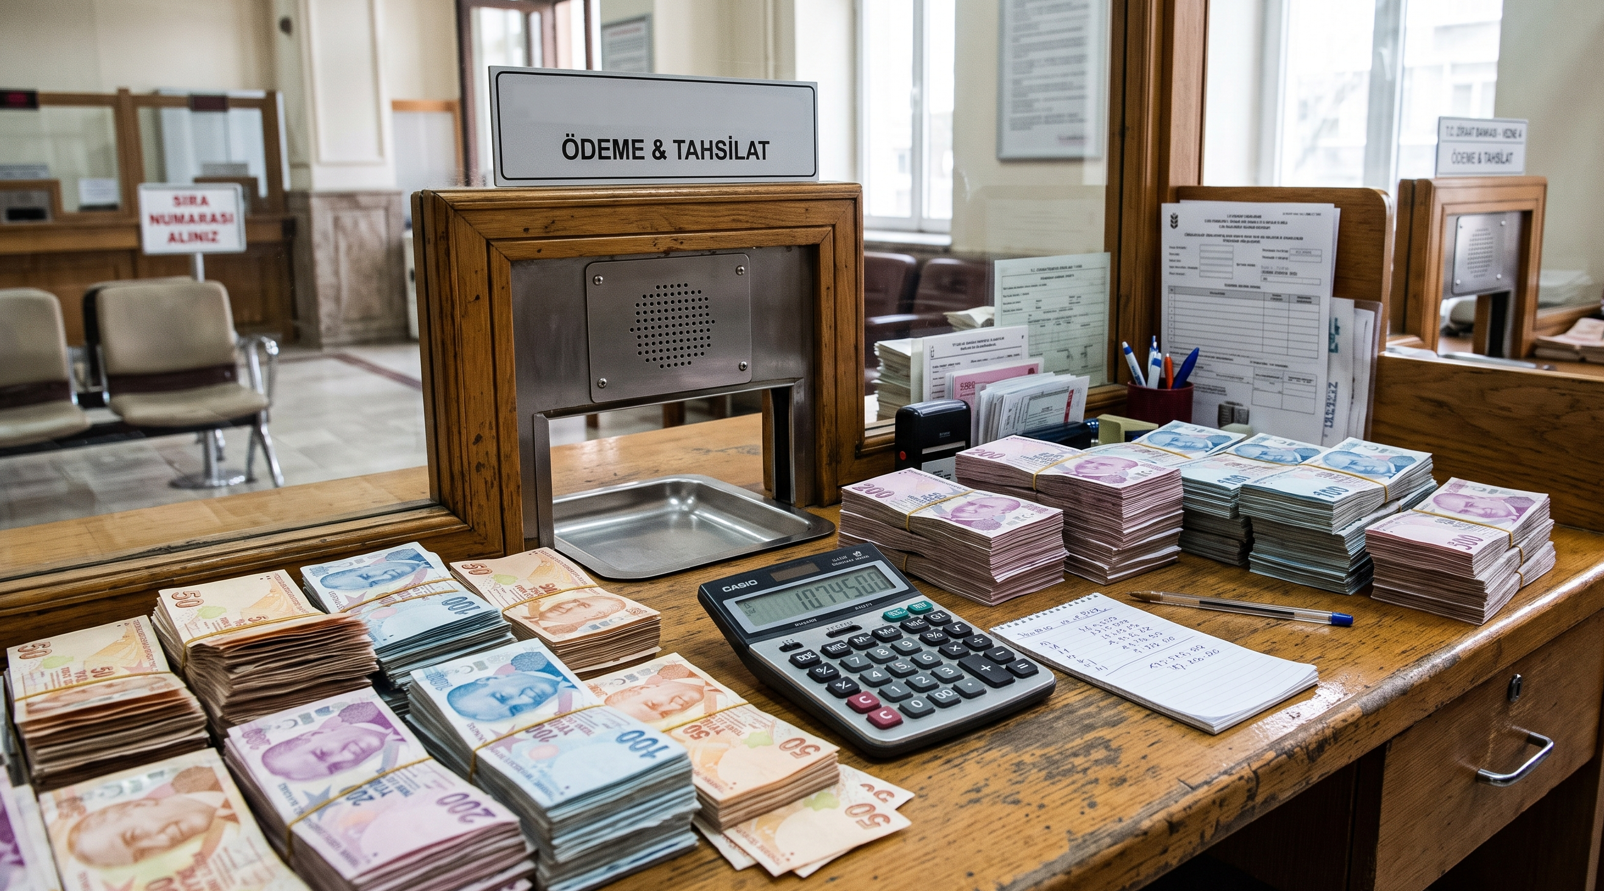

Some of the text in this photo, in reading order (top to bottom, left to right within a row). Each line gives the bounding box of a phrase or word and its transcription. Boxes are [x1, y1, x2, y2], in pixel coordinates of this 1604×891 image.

[561, 133, 770, 161] ÖDEME & TAHSİLAT
[1451, 149, 1476, 164] ÖDEME
[1484, 149, 1513, 164] TAHSİLAT
[173, 195, 209, 207] SIRA
[149, 212, 234, 225] NUMARASI
[168, 231, 218, 243] ALINIZ
[852, 483, 894, 499] 200
[1313, 485, 1349, 498] 100
[722, 579, 758, 593] CASIO
[796, 571, 890, 610] 1074500
[171, 590, 204, 609] 50
[442, 596, 481, 615] 100
[18, 641, 52, 660] 50
[850, 656, 860, 664] 7
[877, 648, 889, 656] 8
[902, 640, 912, 648] 9
[872, 670, 882, 678] 4
[922, 653, 933, 661] 6
[859, 695, 872, 704] C
[891, 685, 901, 693] 1
[916, 676, 930, 684] 2
[941, 667, 954, 675] 3
[880, 710, 893, 719] C
[911, 699, 923, 708] 0
[615, 729, 670, 759] 100
[778, 737, 821, 760] 50
[340, 784, 375, 807] 20
[435, 792, 497, 823] 200
[845, 802, 891, 830] 50
